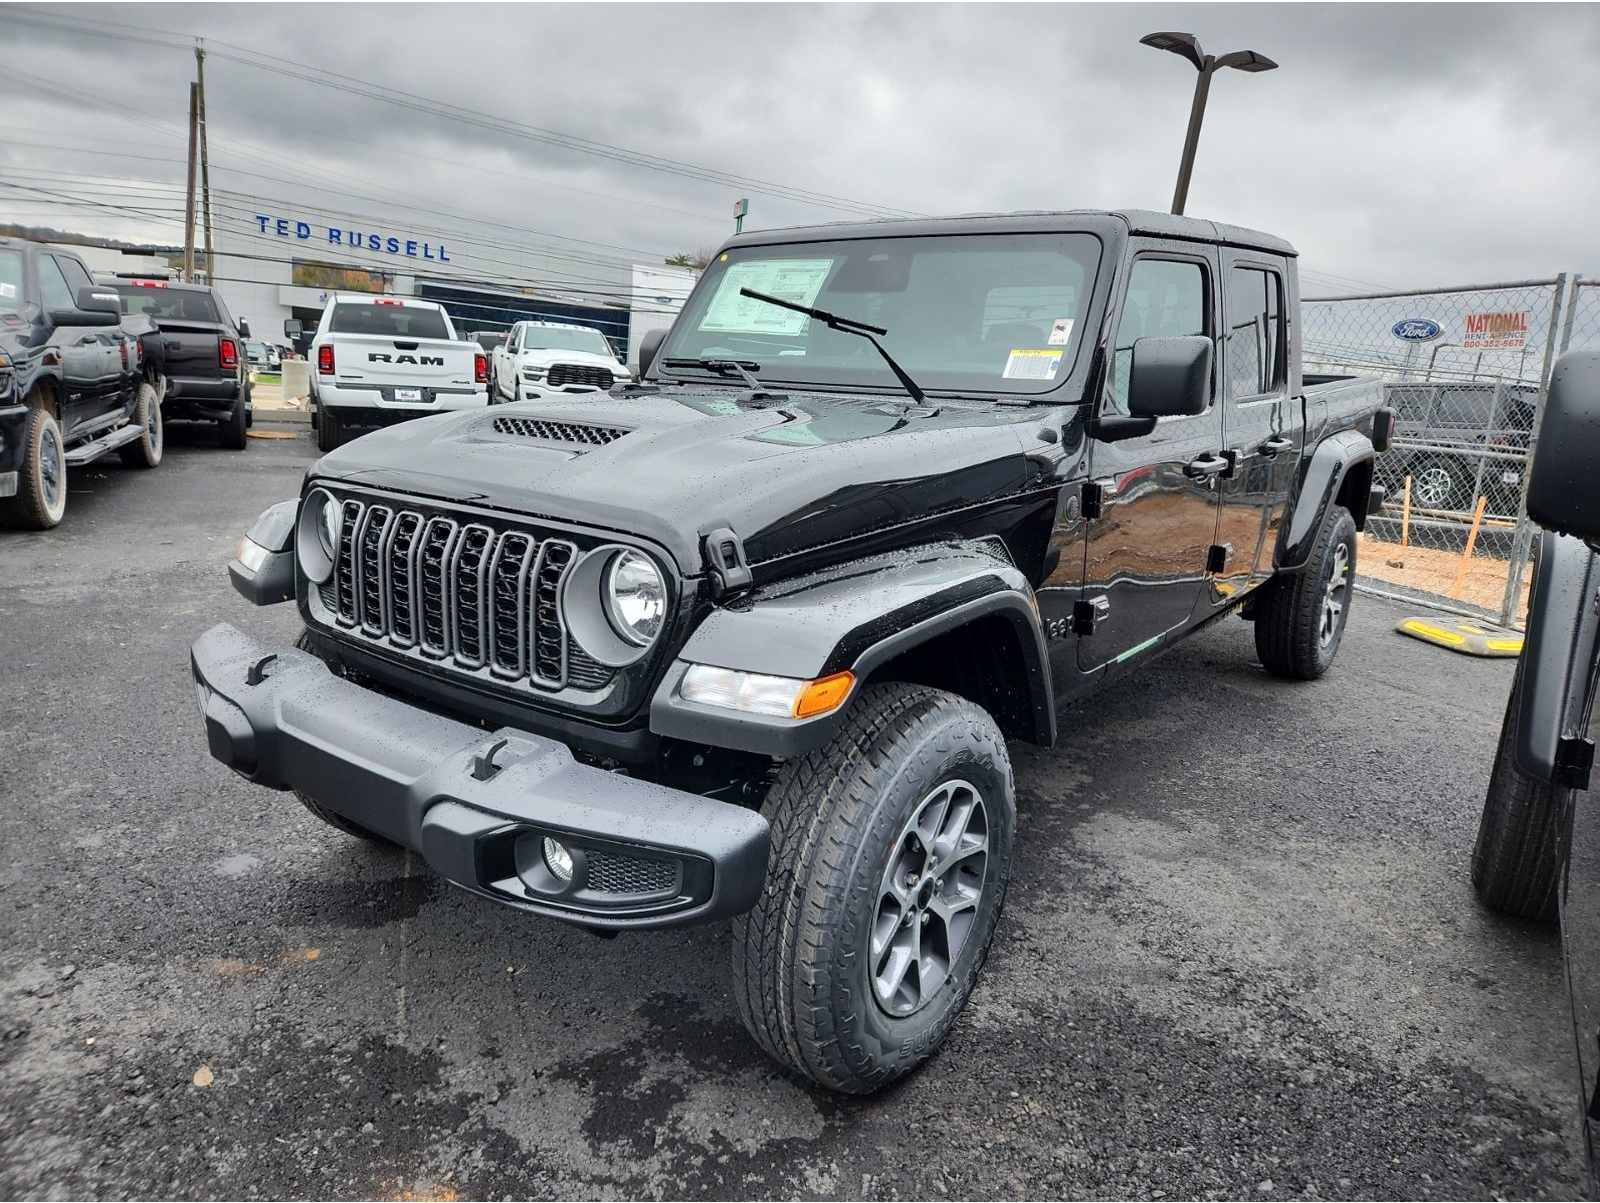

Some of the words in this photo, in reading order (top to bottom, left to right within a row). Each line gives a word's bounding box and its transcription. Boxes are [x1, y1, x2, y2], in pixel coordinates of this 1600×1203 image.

[256, 214, 311, 240] TED
[328, 227, 450, 261] RUSSELL
[1466, 312, 1527, 333] NATIONAL
[368, 353, 444, 366] RAM
